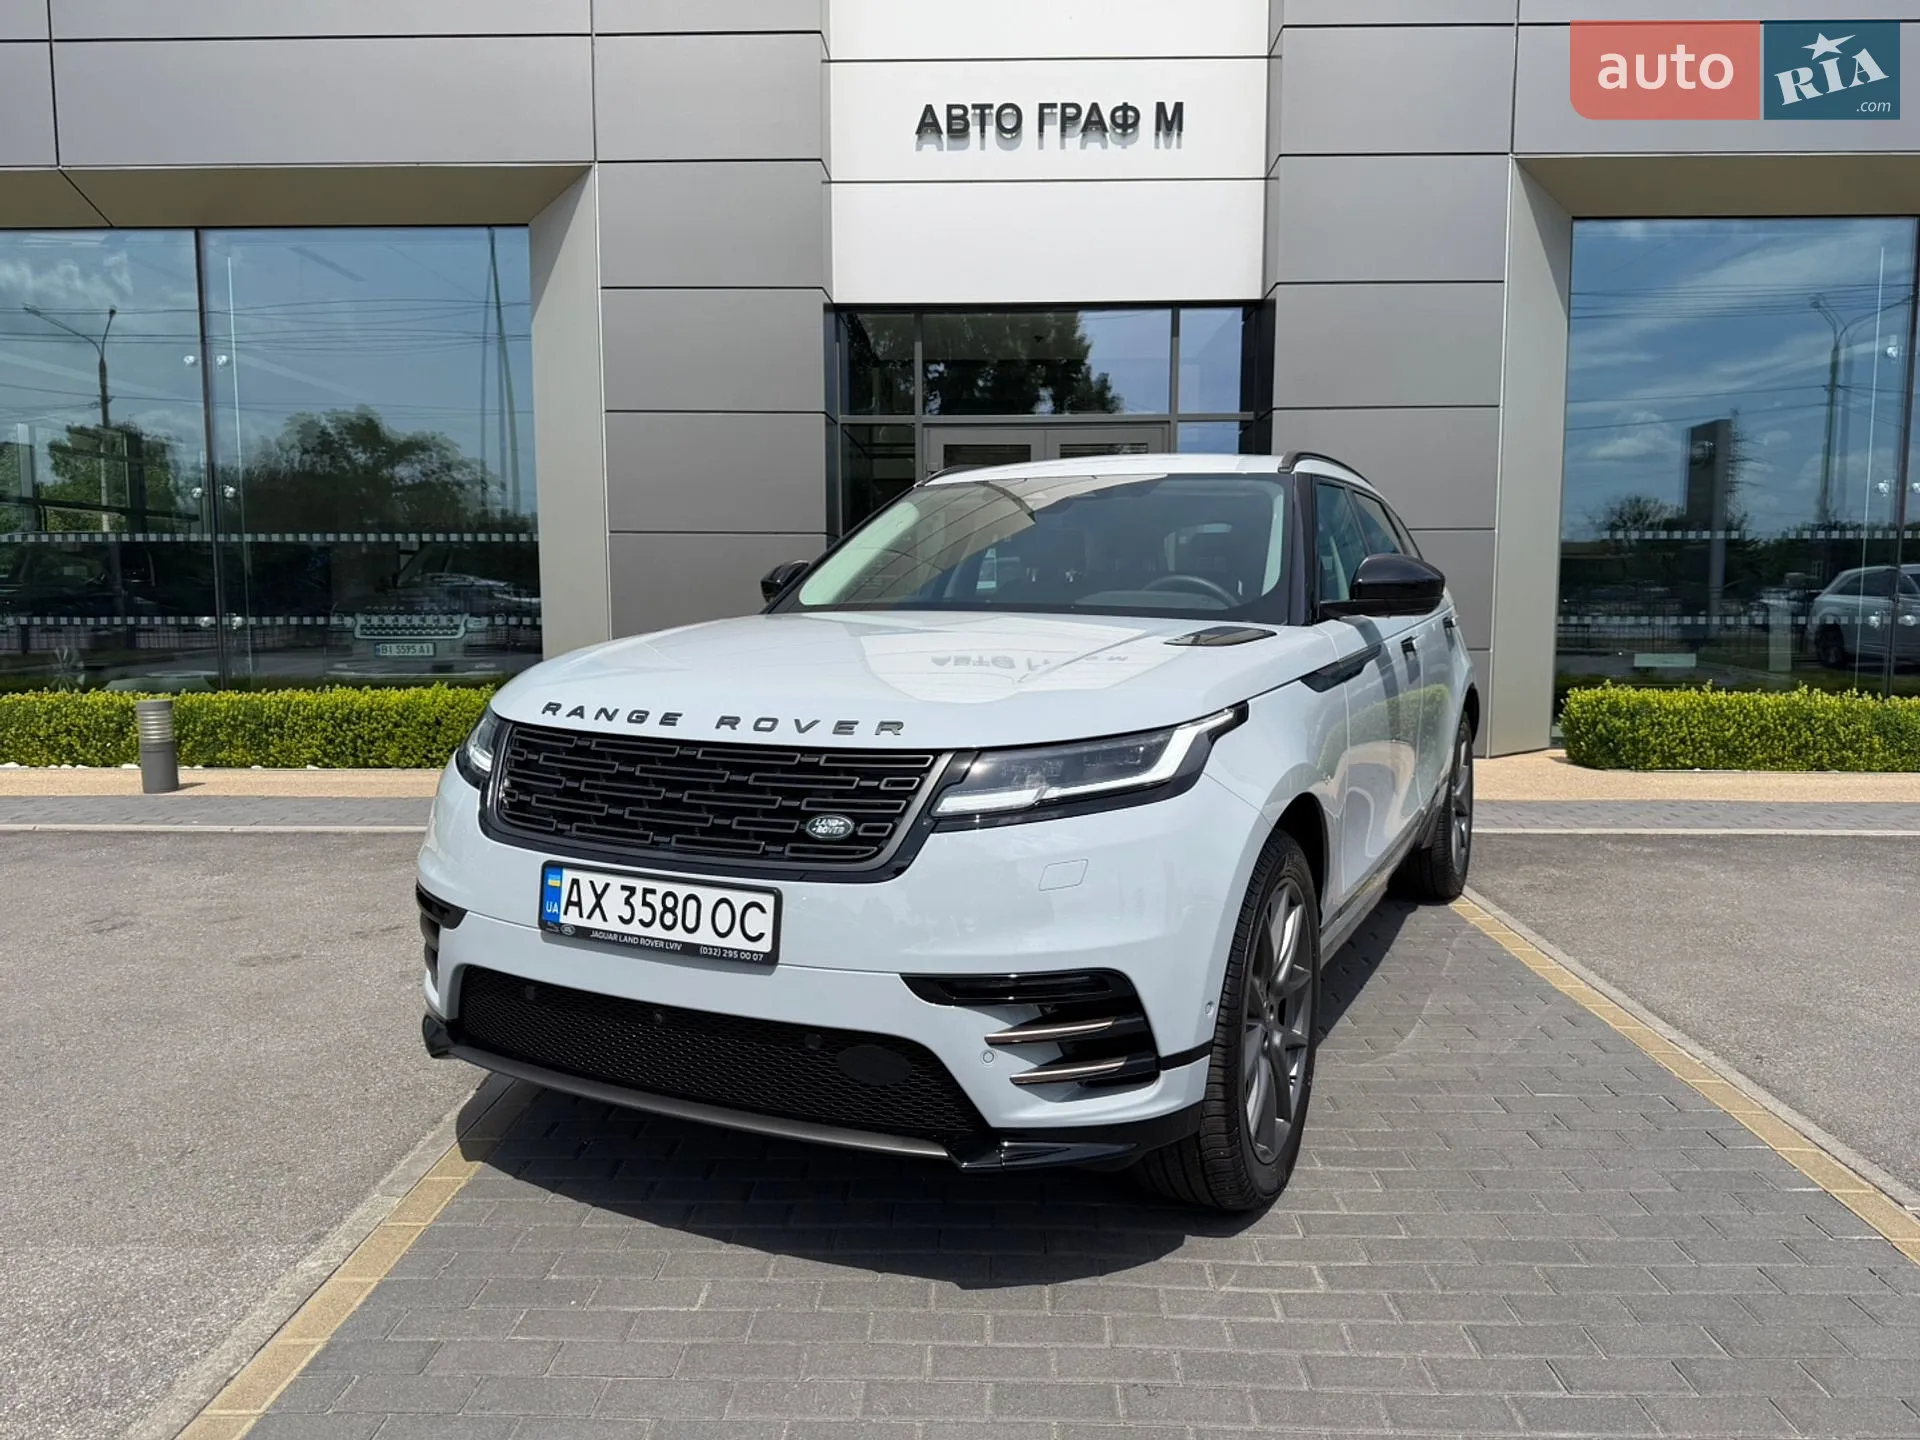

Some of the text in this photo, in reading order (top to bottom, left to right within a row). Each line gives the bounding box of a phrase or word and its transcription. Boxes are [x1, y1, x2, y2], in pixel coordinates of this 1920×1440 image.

[915, 101, 1185, 136] АВТО ГРАФ М
[541, 702, 905, 737] RANGE ROVER
[546, 900, 559, 915] UA
[562, 877, 768, 943] AX 3580 OC
[590, 930, 618, 942] JAGUAR
[618, 935, 639, 944] LAND
[639, 938, 665, 949] ROVER
[665, 940, 683, 951] LVIV
[699, 946, 764, 962] (032) 295 00 07
